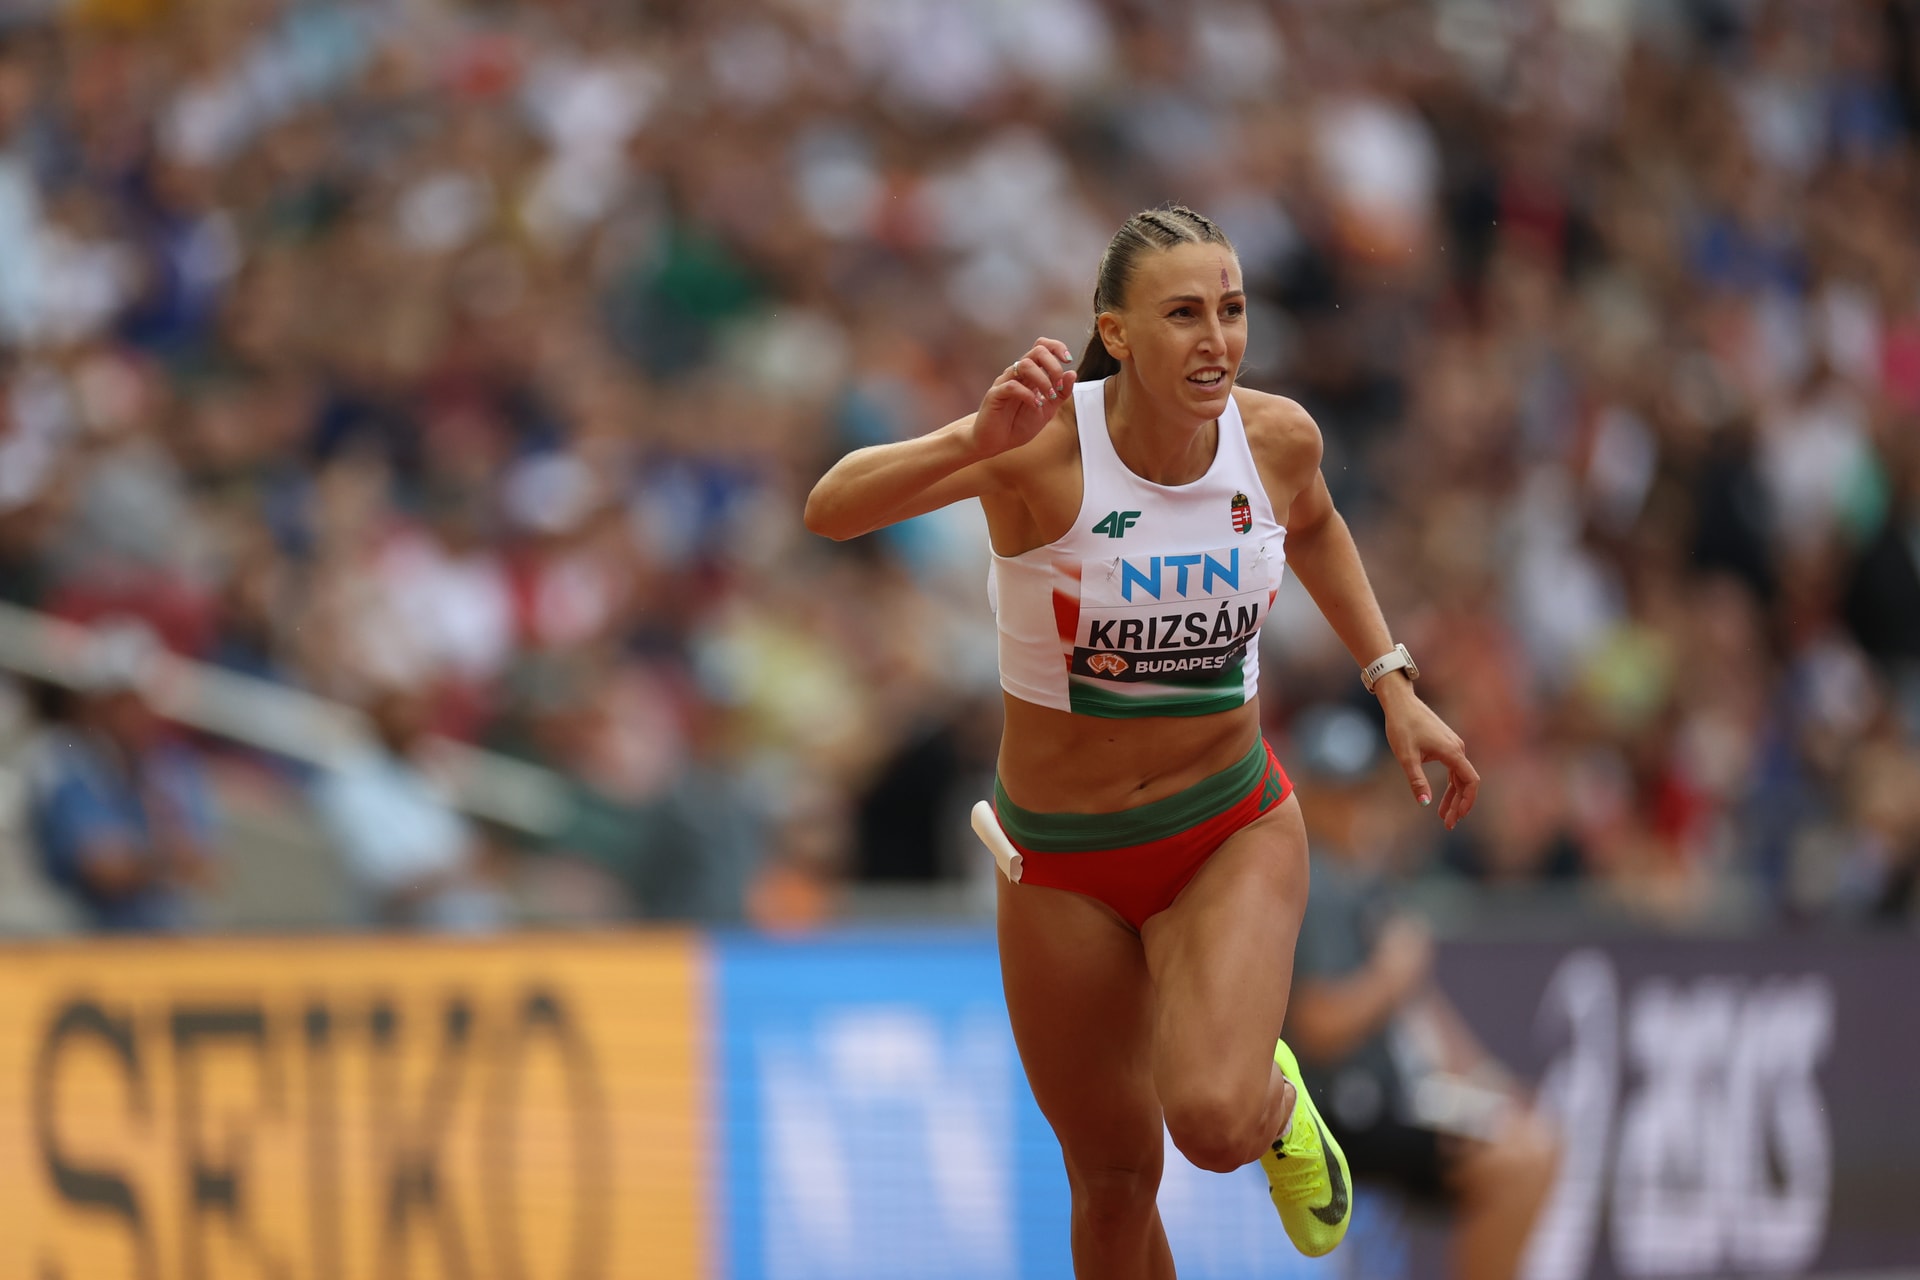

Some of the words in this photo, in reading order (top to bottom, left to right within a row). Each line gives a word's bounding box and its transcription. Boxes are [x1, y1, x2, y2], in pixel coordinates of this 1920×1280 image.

[1092, 511, 1142, 538] 4F
[1121, 548, 1239, 603] NTN
[1088, 601, 1259, 650] KRIZSÁN
[1135, 651, 1231, 674] BUDAPES
[30, 988, 614, 1280] SEIKO
